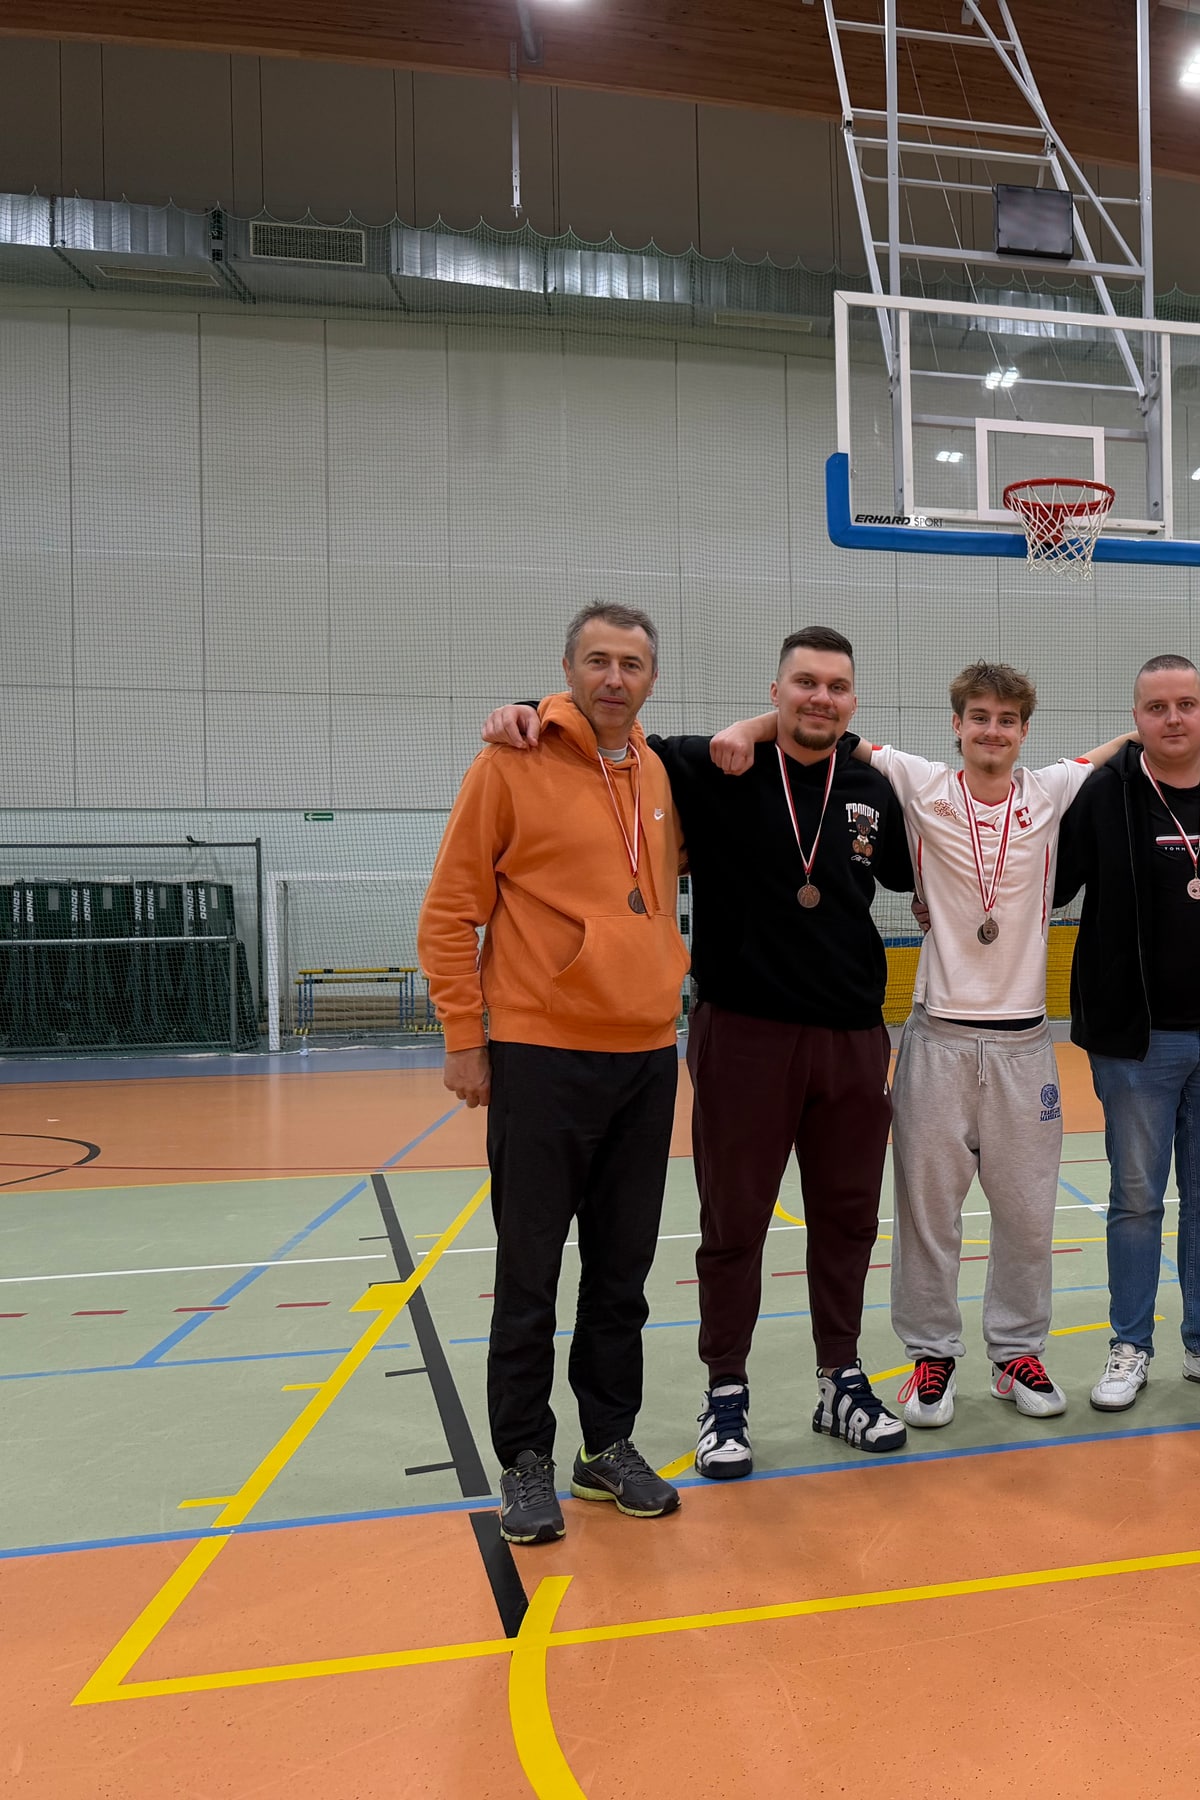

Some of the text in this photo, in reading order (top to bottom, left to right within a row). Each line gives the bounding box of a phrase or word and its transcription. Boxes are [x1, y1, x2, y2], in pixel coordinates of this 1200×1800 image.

[855, 514, 944, 528] ERHARD SPORT
[26, 889, 34, 922] DONIC
[83, 888, 91, 921] DONIC
[198, 888, 207, 920] DONIC
